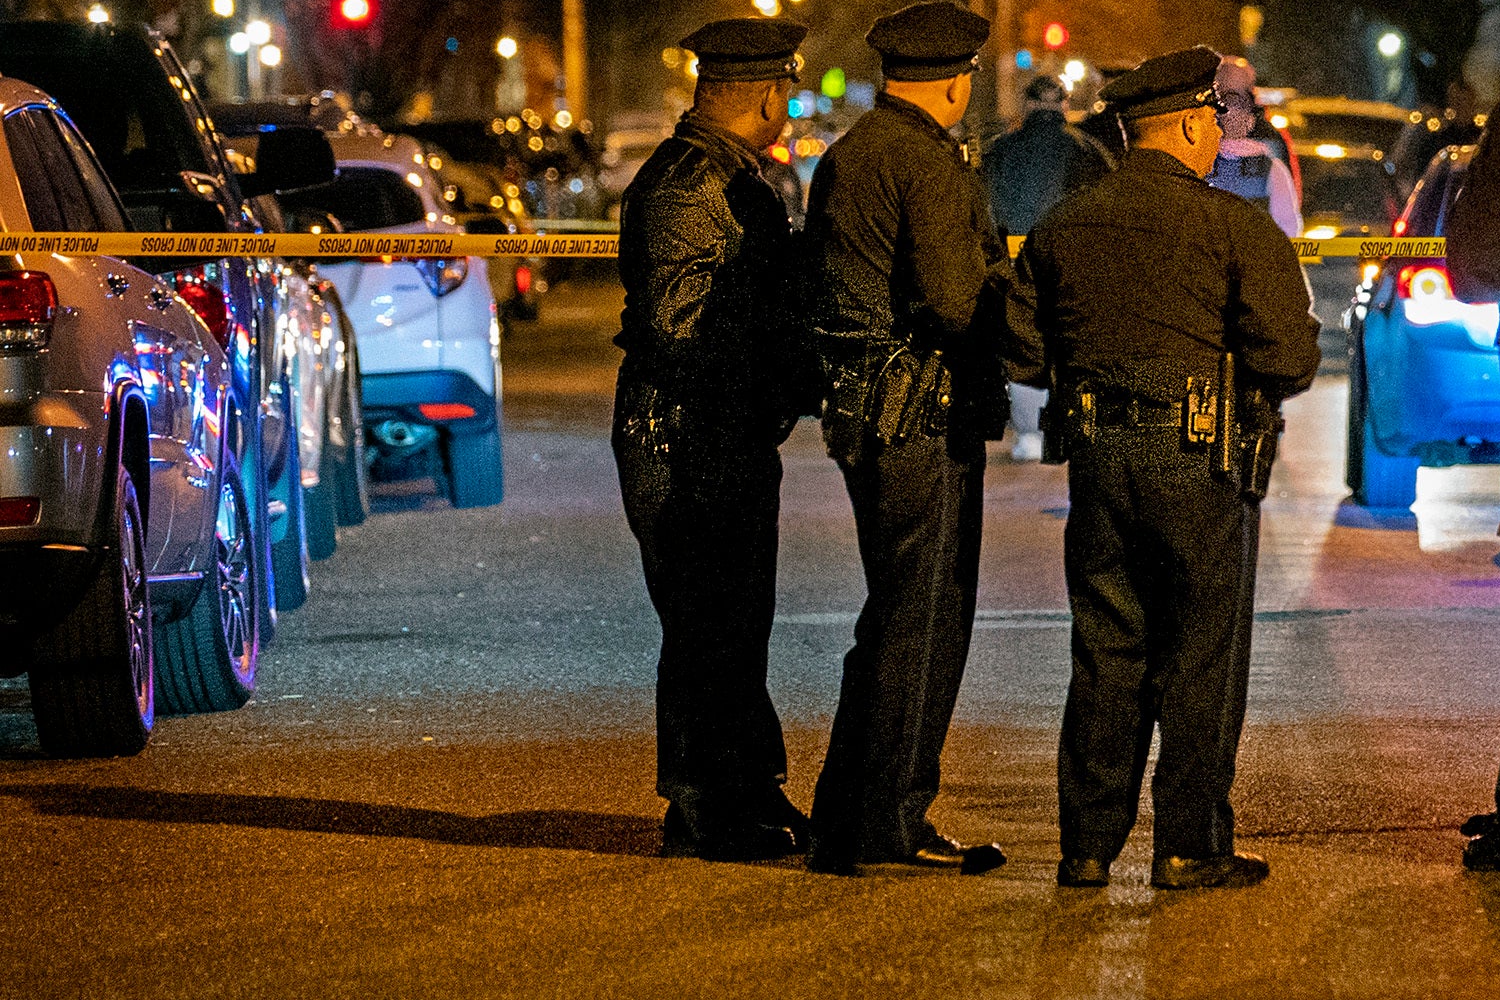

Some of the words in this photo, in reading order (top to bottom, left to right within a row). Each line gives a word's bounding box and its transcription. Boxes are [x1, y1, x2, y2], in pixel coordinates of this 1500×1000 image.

[22, 237, 36, 251] DO
[38, 237, 61, 252] LINE
[62, 237, 99, 252] POLICE
[141, 237, 175, 252] CROSS
[176, 238, 198, 252] NOT
[199, 238, 214, 252] DO
[215, 238, 239, 253] LINE
[240, 238, 276, 253] POLICE
[318, 238, 352, 253] CROSS
[352, 239, 375, 253] NOT
[376, 239, 391, 253] DO
[392, 239, 416, 254] LINE
[416, 239, 453, 254] POLICE
[494, 239, 528, 254] CROSS
[528, 240, 550, 254] NOT
[551, 240, 567, 254] DO
[568, 240, 592, 254] LINE
[1359, 241, 1393, 256] CROSS
[1393, 242, 1413, 256] NOT
[1415, 242, 1430, 256] DO
